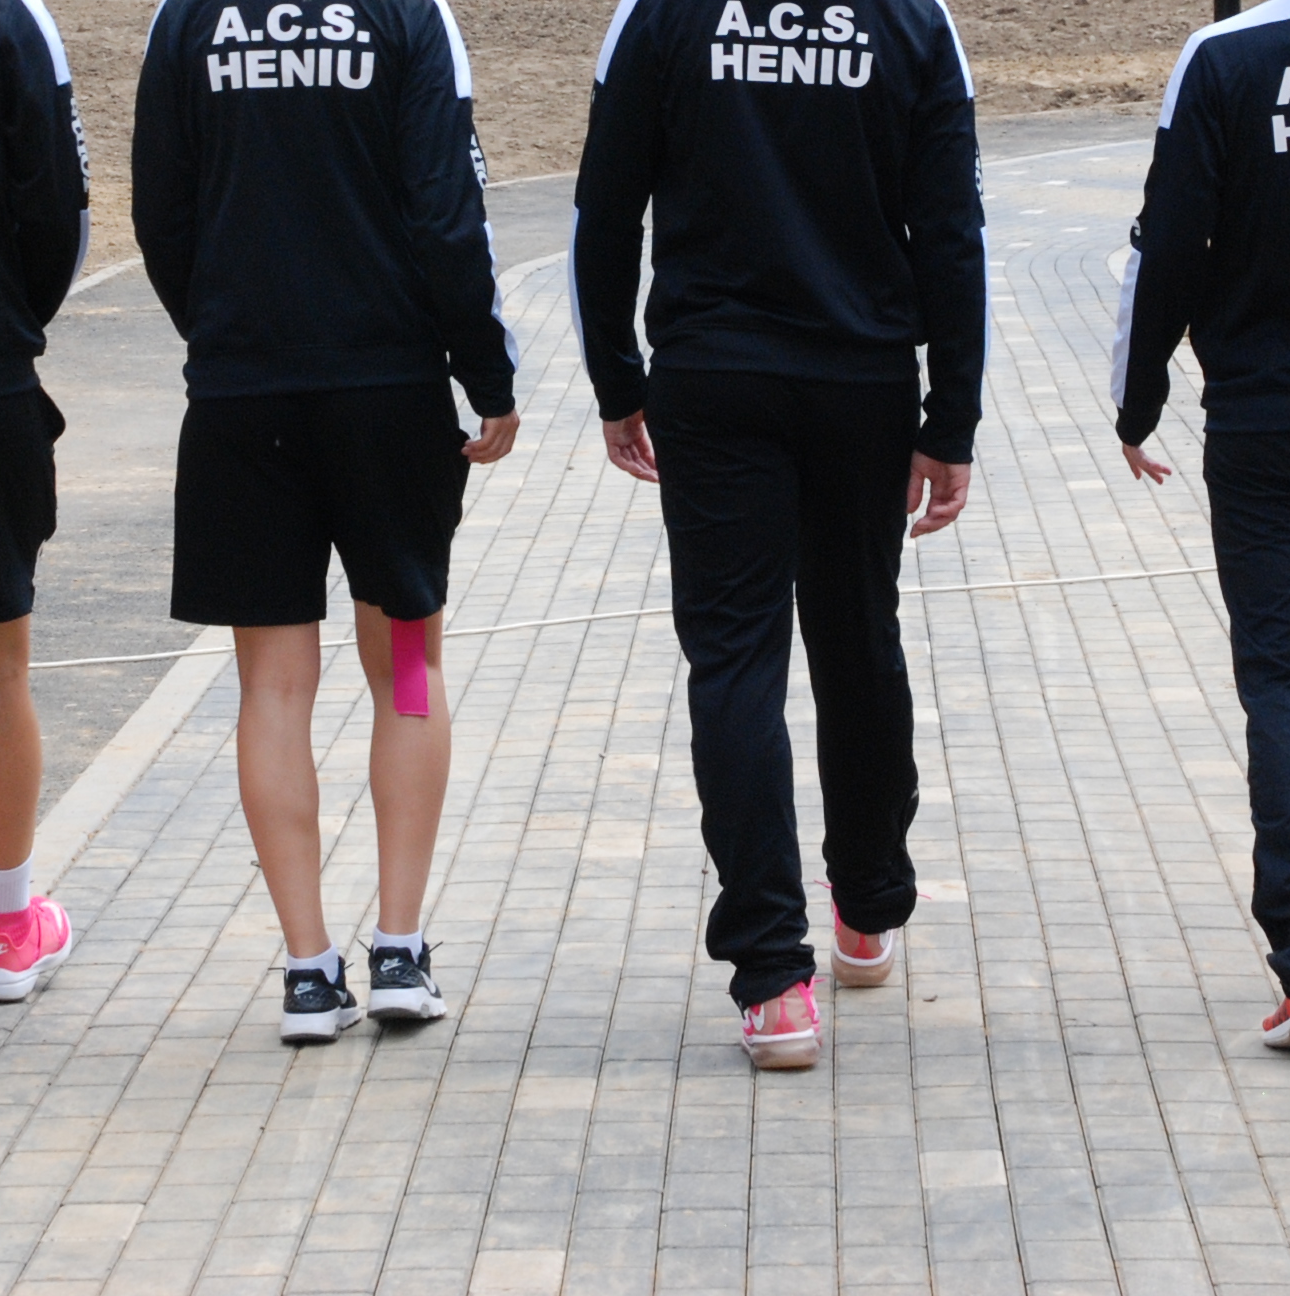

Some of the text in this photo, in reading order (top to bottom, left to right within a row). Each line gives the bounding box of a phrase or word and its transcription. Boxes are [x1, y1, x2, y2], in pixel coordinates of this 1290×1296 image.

[212, 4, 371, 45] A.C.S.
[715, 0, 869, 45] A.C.S.
[206, 48, 375, 92] HENIU
[710, 43, 874, 88] HENIU
